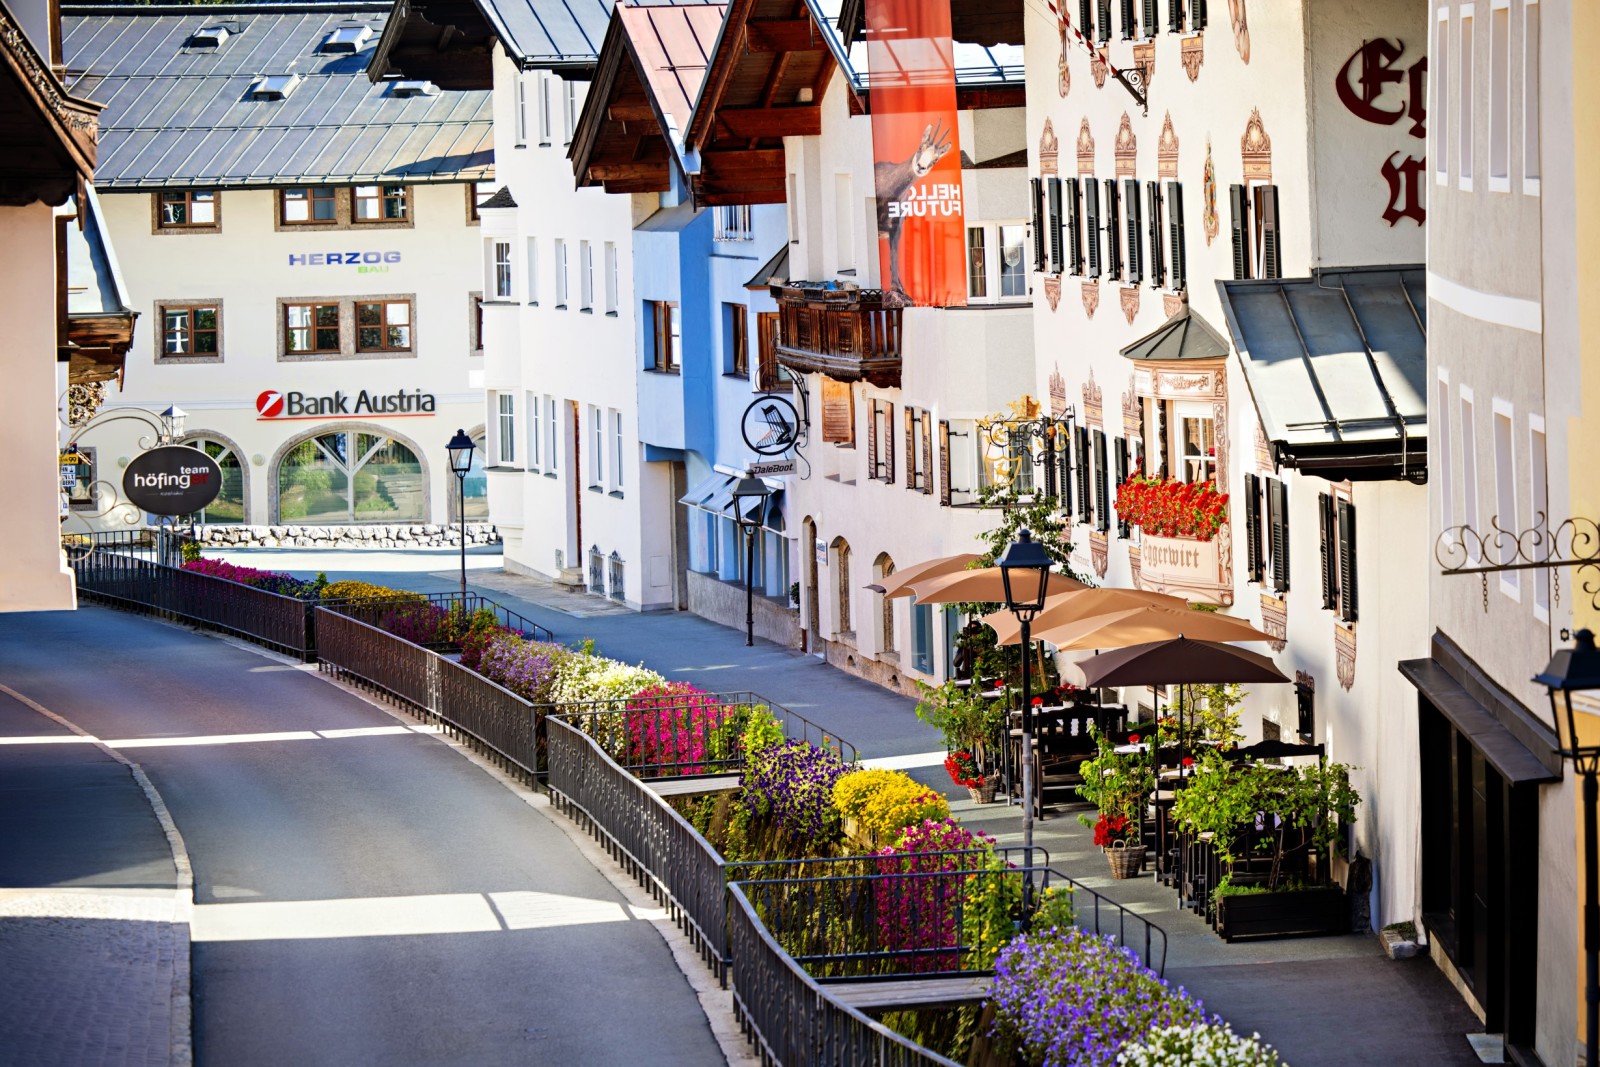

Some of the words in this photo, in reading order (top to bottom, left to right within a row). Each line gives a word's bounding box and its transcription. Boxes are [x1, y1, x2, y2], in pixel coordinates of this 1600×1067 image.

[289, 251, 401, 266] HERZOG
[287, 390, 349, 415] Bank
[354, 388, 435, 413] Austria
[180, 466, 209, 475] team
[753, 463, 793, 475] DaleBoot
[134, 472, 208, 489] höfinger
[1143, 537, 1200, 568] Eggerwirt
